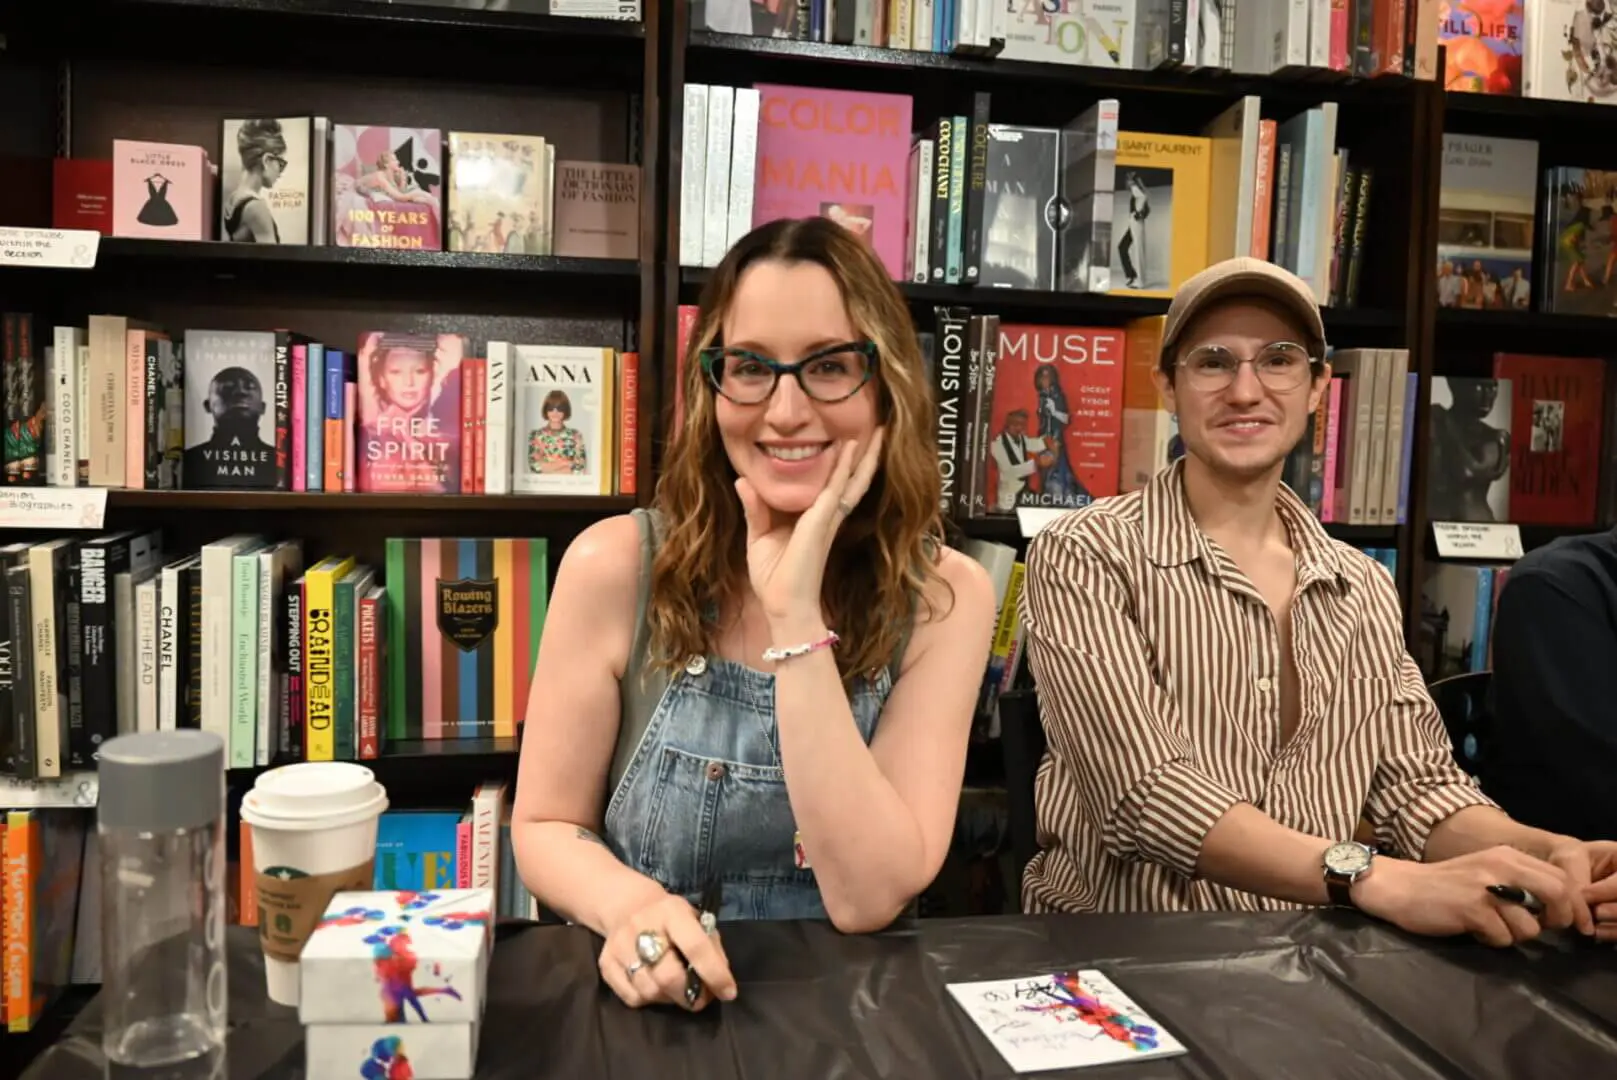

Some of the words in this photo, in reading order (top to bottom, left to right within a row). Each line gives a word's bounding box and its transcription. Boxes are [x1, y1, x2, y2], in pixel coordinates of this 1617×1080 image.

[1480, 19, 1518, 40] LIFE
[761, 95, 901, 137] COLOR
[972, 124, 987, 190] COUTURE
[1122, 139, 1153, 152] SAINT
[1154, 142, 1203, 156] LAURENT
[562, 179, 636, 193] DICTIONARY
[563, 166, 589, 179] THE
[592, 168, 635, 181] LITTLE
[761, 155, 897, 196] MANIA
[937, 155, 949, 200] CHANEL
[269, 191, 305, 200] FASHION
[272, 200, 282, 209] IN
[561, 191, 579, 200] OF
[582, 191, 637, 204] FASHION
[349, 209, 375, 223] 100
[376, 210, 428, 225] YEARS
[380, 224, 395, 233] OF
[351, 234, 423, 248] FASHION
[130, 344, 140, 372] MISS
[276, 346, 287, 365] PAT
[941, 324, 963, 391] LOUIS
[999, 331, 1116, 366] MUSE
[147, 355, 157, 397] CHANEL
[491, 361, 503, 402] ANNA
[525, 364, 592, 384] ANNA
[624, 368, 637, 400] HOW
[106, 372, 115, 419] CHRISTIAN
[130, 375, 140, 406] DIOR
[276, 382, 287, 409] CITY
[62, 393, 71, 424] COCO
[624, 407, 636, 425] TO
[1077, 409, 1095, 417] AND
[230, 435, 241, 446] A
[376, 417, 441, 438] FREE
[624, 428, 636, 444] BE
[62, 428, 71, 471] CHANEL
[203, 450, 268, 462] VISIBLE
[367, 442, 450, 461] SPIRIT
[938, 397, 959, 496] VUITTON
[216, 465, 256, 476] MAN
[624, 448, 635, 477] OLD
[80, 548, 106, 604] BANGER
[442, 588, 492, 603] Rowing
[443, 602, 493, 614] Blazers
[288, 594, 301, 648] STEPPING
[361, 604, 374, 644] POCKETS
[37, 622, 45, 653] CHANEL
[43, 618, 51, 657] GABRIELLE
[161, 606, 172, 672] CHANEL
[237, 633, 249, 690] Enchanted
[288, 649, 300, 672] OUT
[38, 670, 47, 712] MANIFESTO
[45, 674, 53, 707] FASHION
[237, 692, 249, 724] World
[459, 833, 468, 879] FABULOUS
